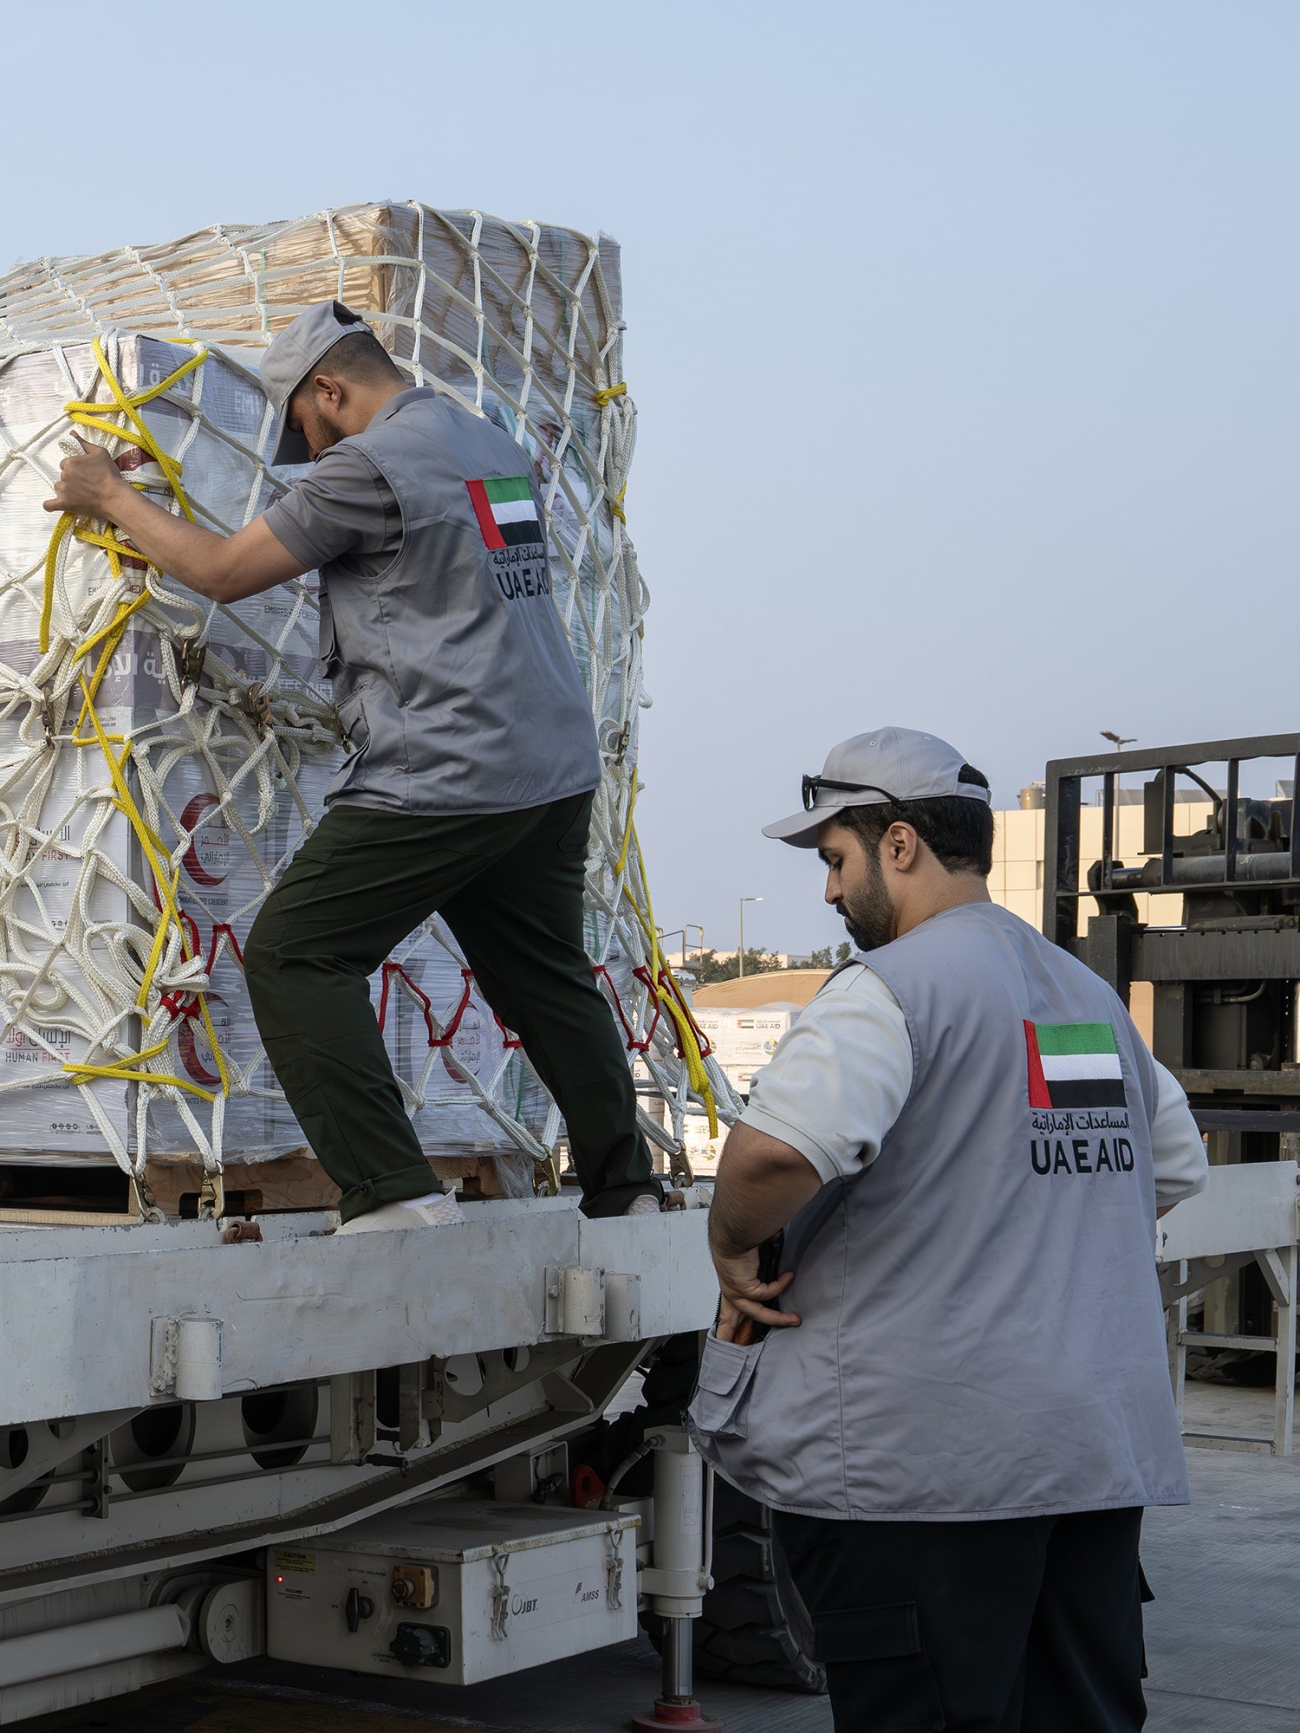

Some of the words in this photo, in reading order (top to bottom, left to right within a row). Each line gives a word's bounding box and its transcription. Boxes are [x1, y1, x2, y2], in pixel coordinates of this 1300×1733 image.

[496, 567, 535, 600] UAE
[5, 1052, 39, 1063] HUMAN
[1031, 1139, 1093, 1176] UAE
[1096, 1138, 1135, 1173] AID
[521, 1598, 538, 1615] JBT
